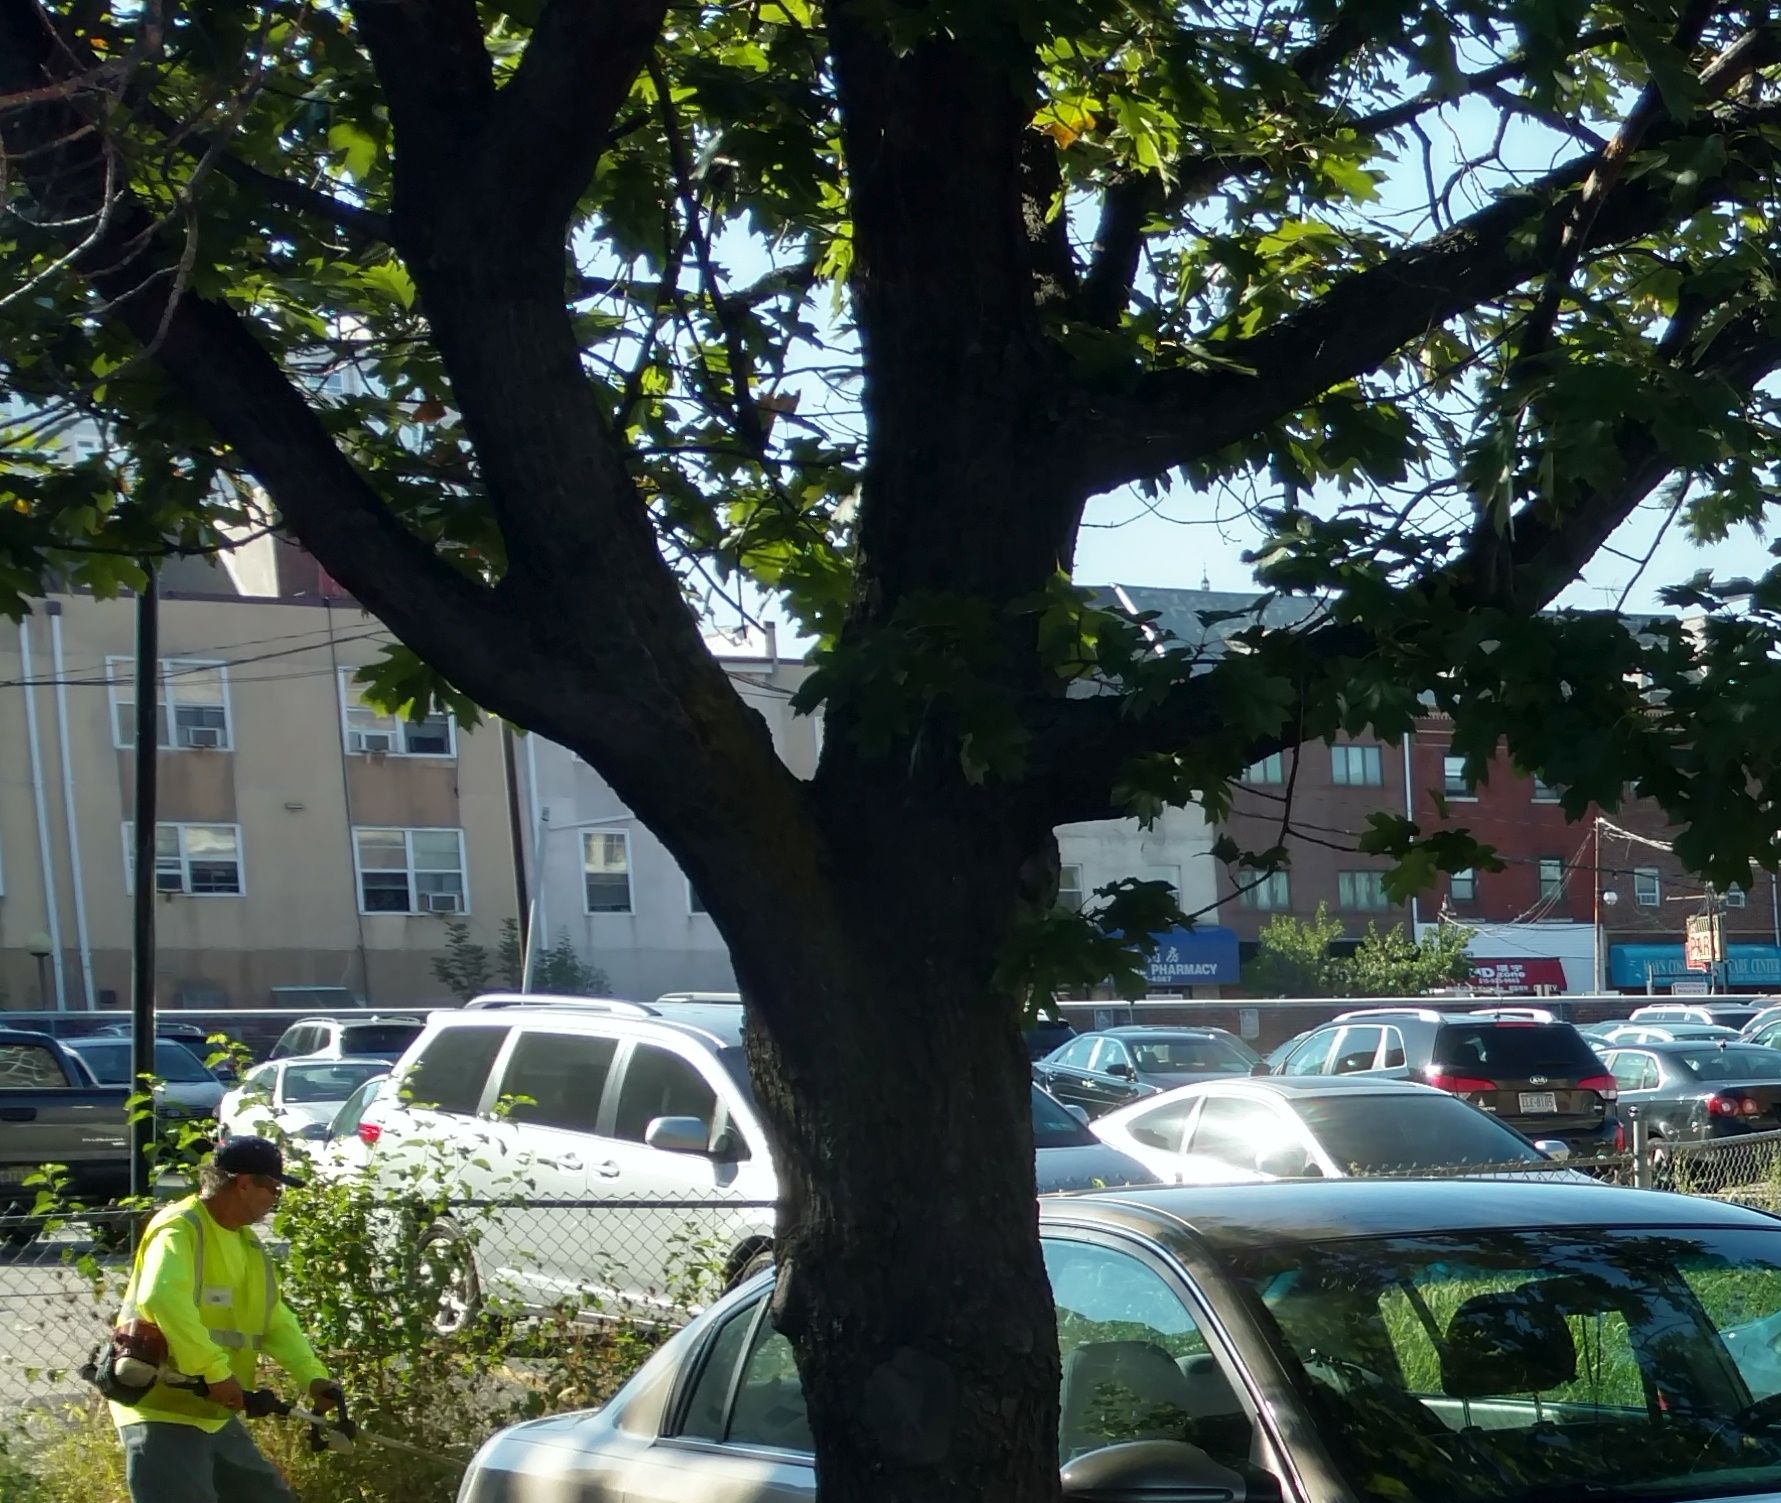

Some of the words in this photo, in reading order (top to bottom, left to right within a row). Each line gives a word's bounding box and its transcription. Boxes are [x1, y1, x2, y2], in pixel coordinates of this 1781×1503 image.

[1151, 963, 1218, 976] PHARMACY
[1729, 958, 1749, 974] CARE
[1751, 958, 1781, 974] CENTER
